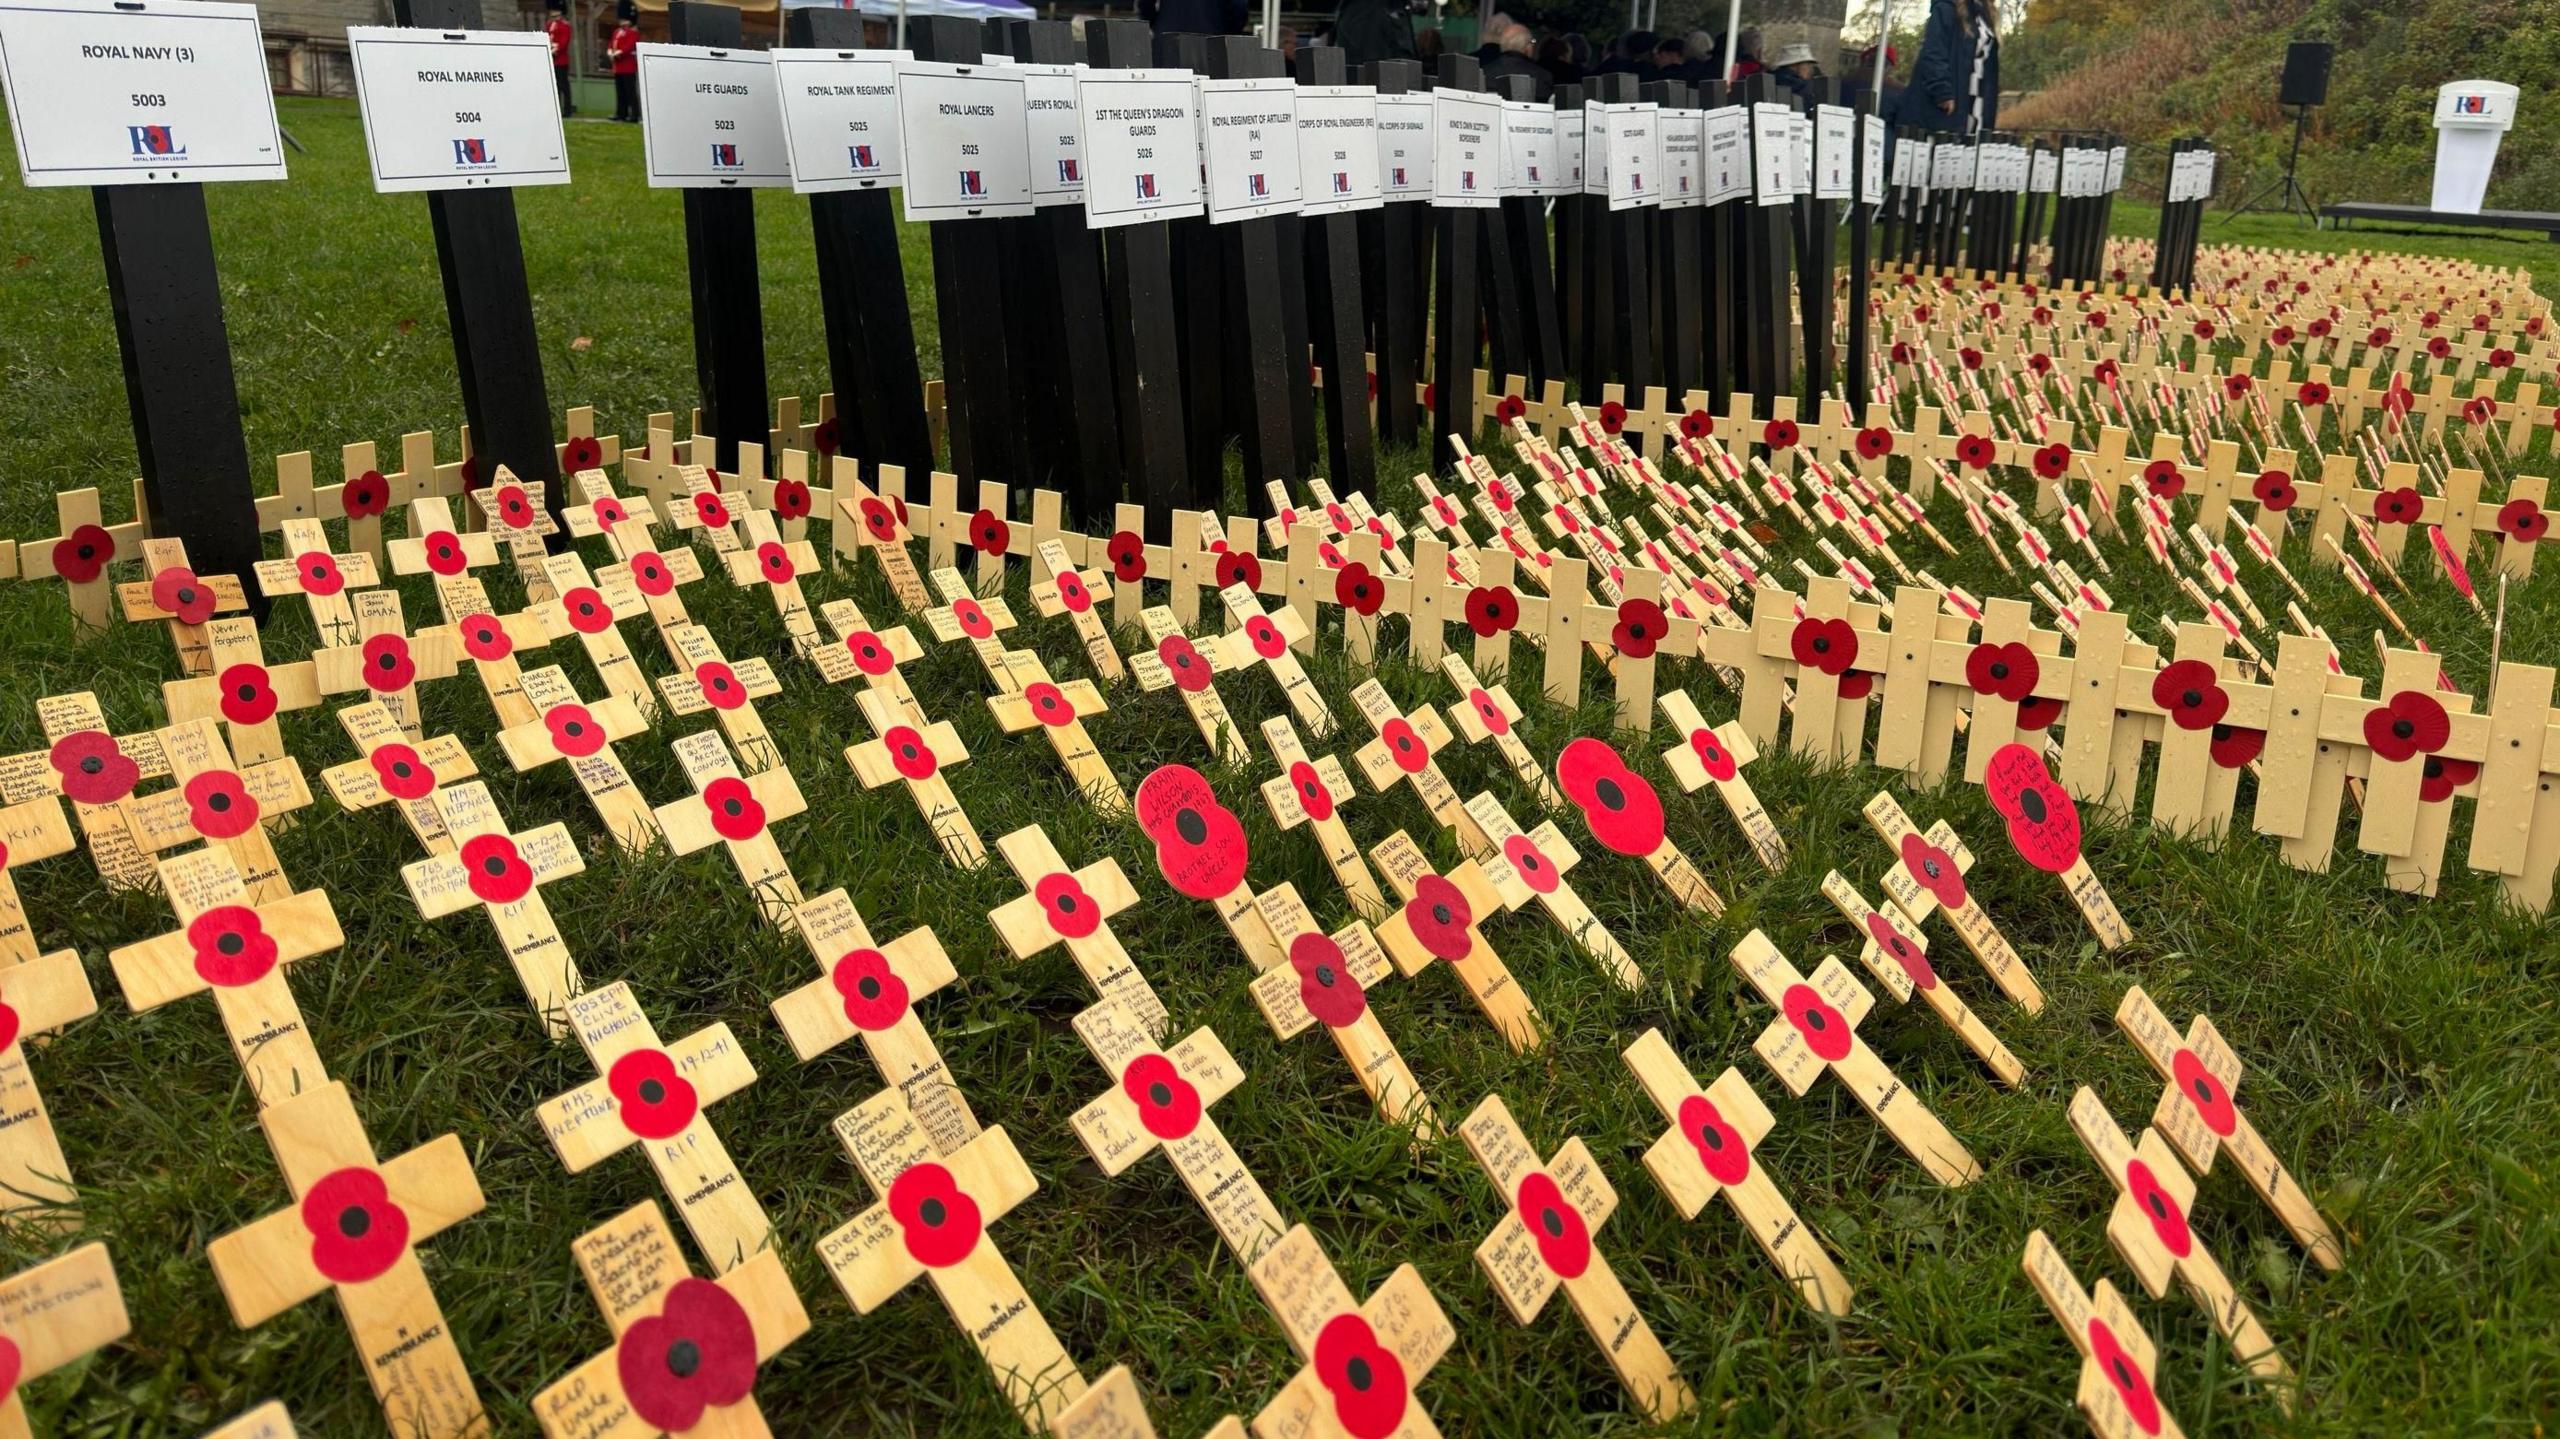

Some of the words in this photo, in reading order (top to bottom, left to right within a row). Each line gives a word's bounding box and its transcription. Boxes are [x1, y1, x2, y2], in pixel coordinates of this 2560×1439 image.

[82, 45, 130, 60] ROYAL
[134, 46, 172, 61] NAVY
[176, 47, 194, 63] (3)
[418, 71, 451, 84] ROYAL
[455, 71, 505, 84] MARINES
[695, 83, 712, 94] LIFE
[713, 85, 748, 96] GUARDS
[807, 86, 832, 96] ROYAL
[834, 86, 855, 96] TANK
[856, 85, 895, 96] REGIMENT
[132, 94, 166, 107] 5003
[1053, 100, 1072, 111] ROYAL
[456, 113, 482, 124] 5004
[939, 104, 963, 115] ROYAL
[964, 105, 994, 117] LANCERS
[1096, 109, 1108, 121] 1ST
[1109, 109, 1122, 121] THE
[1123, 109, 1151, 121] QUEEN'S
[1152, 108, 1184, 120] DRAGOON
[715, 120, 735, 131] 5023
[849, 122, 868, 132] 5025
[1212, 116, 1230, 127] ROYAL
[1231, 115, 1259, 126] REGIMENT
[1259, 114, 1266, 125] OF
[1266, 113, 1292, 125] ARTILLERY
[1299, 119, 1315, 129] CORPS
[1316, 119, 1322, 129] OF
[1323, 119, 1338, 129] ROYAL
[1339, 118, 1364, 129] ENGINEERS
[1365, 117, 1375, 129] (RE)
[1129, 125, 1156, 137] GUARDS
[1249, 130, 1261, 142] (RA)
[1059, 135, 1075, 146] 5025
[962, 144, 979, 155] 5025
[1137, 148, 1153, 159] 5026
[1250, 150, 1263, 161] 5027
[362, 607, 397, 618] LOMAX
[212, 624, 240, 636] Never
[214, 635, 255, 647] forgotten
[599, 655, 630, 668] REMEMBRANCE
[520, 669, 557, 684] CHARLES
[529, 684, 566, 700] LOMAX
[170, 728, 203, 743] ARMY
[1067, 749, 1096, 762] REMEMBRANCE
[334, 771, 345, 780] IN
[342, 780, 378, 796] MEMORY
[364, 792, 378, 801] OF
[1150, 781, 1184, 812] WILSON
[752, 869, 789, 888] REMEMBRANCE
[801, 905, 831, 921] THANK
[833, 896, 849, 911] YOU
[810, 917, 828, 931] FOR
[829, 909, 853, 926] YOUR
[815, 920, 856, 942] COURAGE
[512, 935, 557, 956] REMEMBRANCE
[1483, 975, 1510, 1001] REMEMBRANCE
[570, 983, 625, 1018] JOSEPH
[582, 1002, 626, 1027] CLIVE
[241, 1021, 301, 1048] REMEMBRANCE
[587, 1012, 641, 1047] NICHOLLS
[1175, 1043, 1195, 1059] HMS
[1363, 1049, 1396, 1075] REMEMBRANCE
[899, 1061, 943, 1092] REMEMBRANCE
[561, 1091, 594, 1112] HMS
[1876, 1082, 1901, 1114] REMEMBRANCE
[551, 1097, 615, 1140] NEPTUNE
[665, 1133, 697, 1163] RIP
[700, 1174, 708, 1183] IN
[1205, 1169, 1245, 1201] REMEMBRANCE
[684, 1172, 736, 1206] REMEMBRANCE
[582, 1232, 616, 1251] The
[824, 1225, 863, 1257] Died
[865, 1223, 895, 1252] 1943
[1772, 1218, 1798, 1251] REMEMBRANCE
[977, 1298, 1027, 1342] REMEMBRANCE
[374, 1324, 442, 1369] REMEMBRANCE
